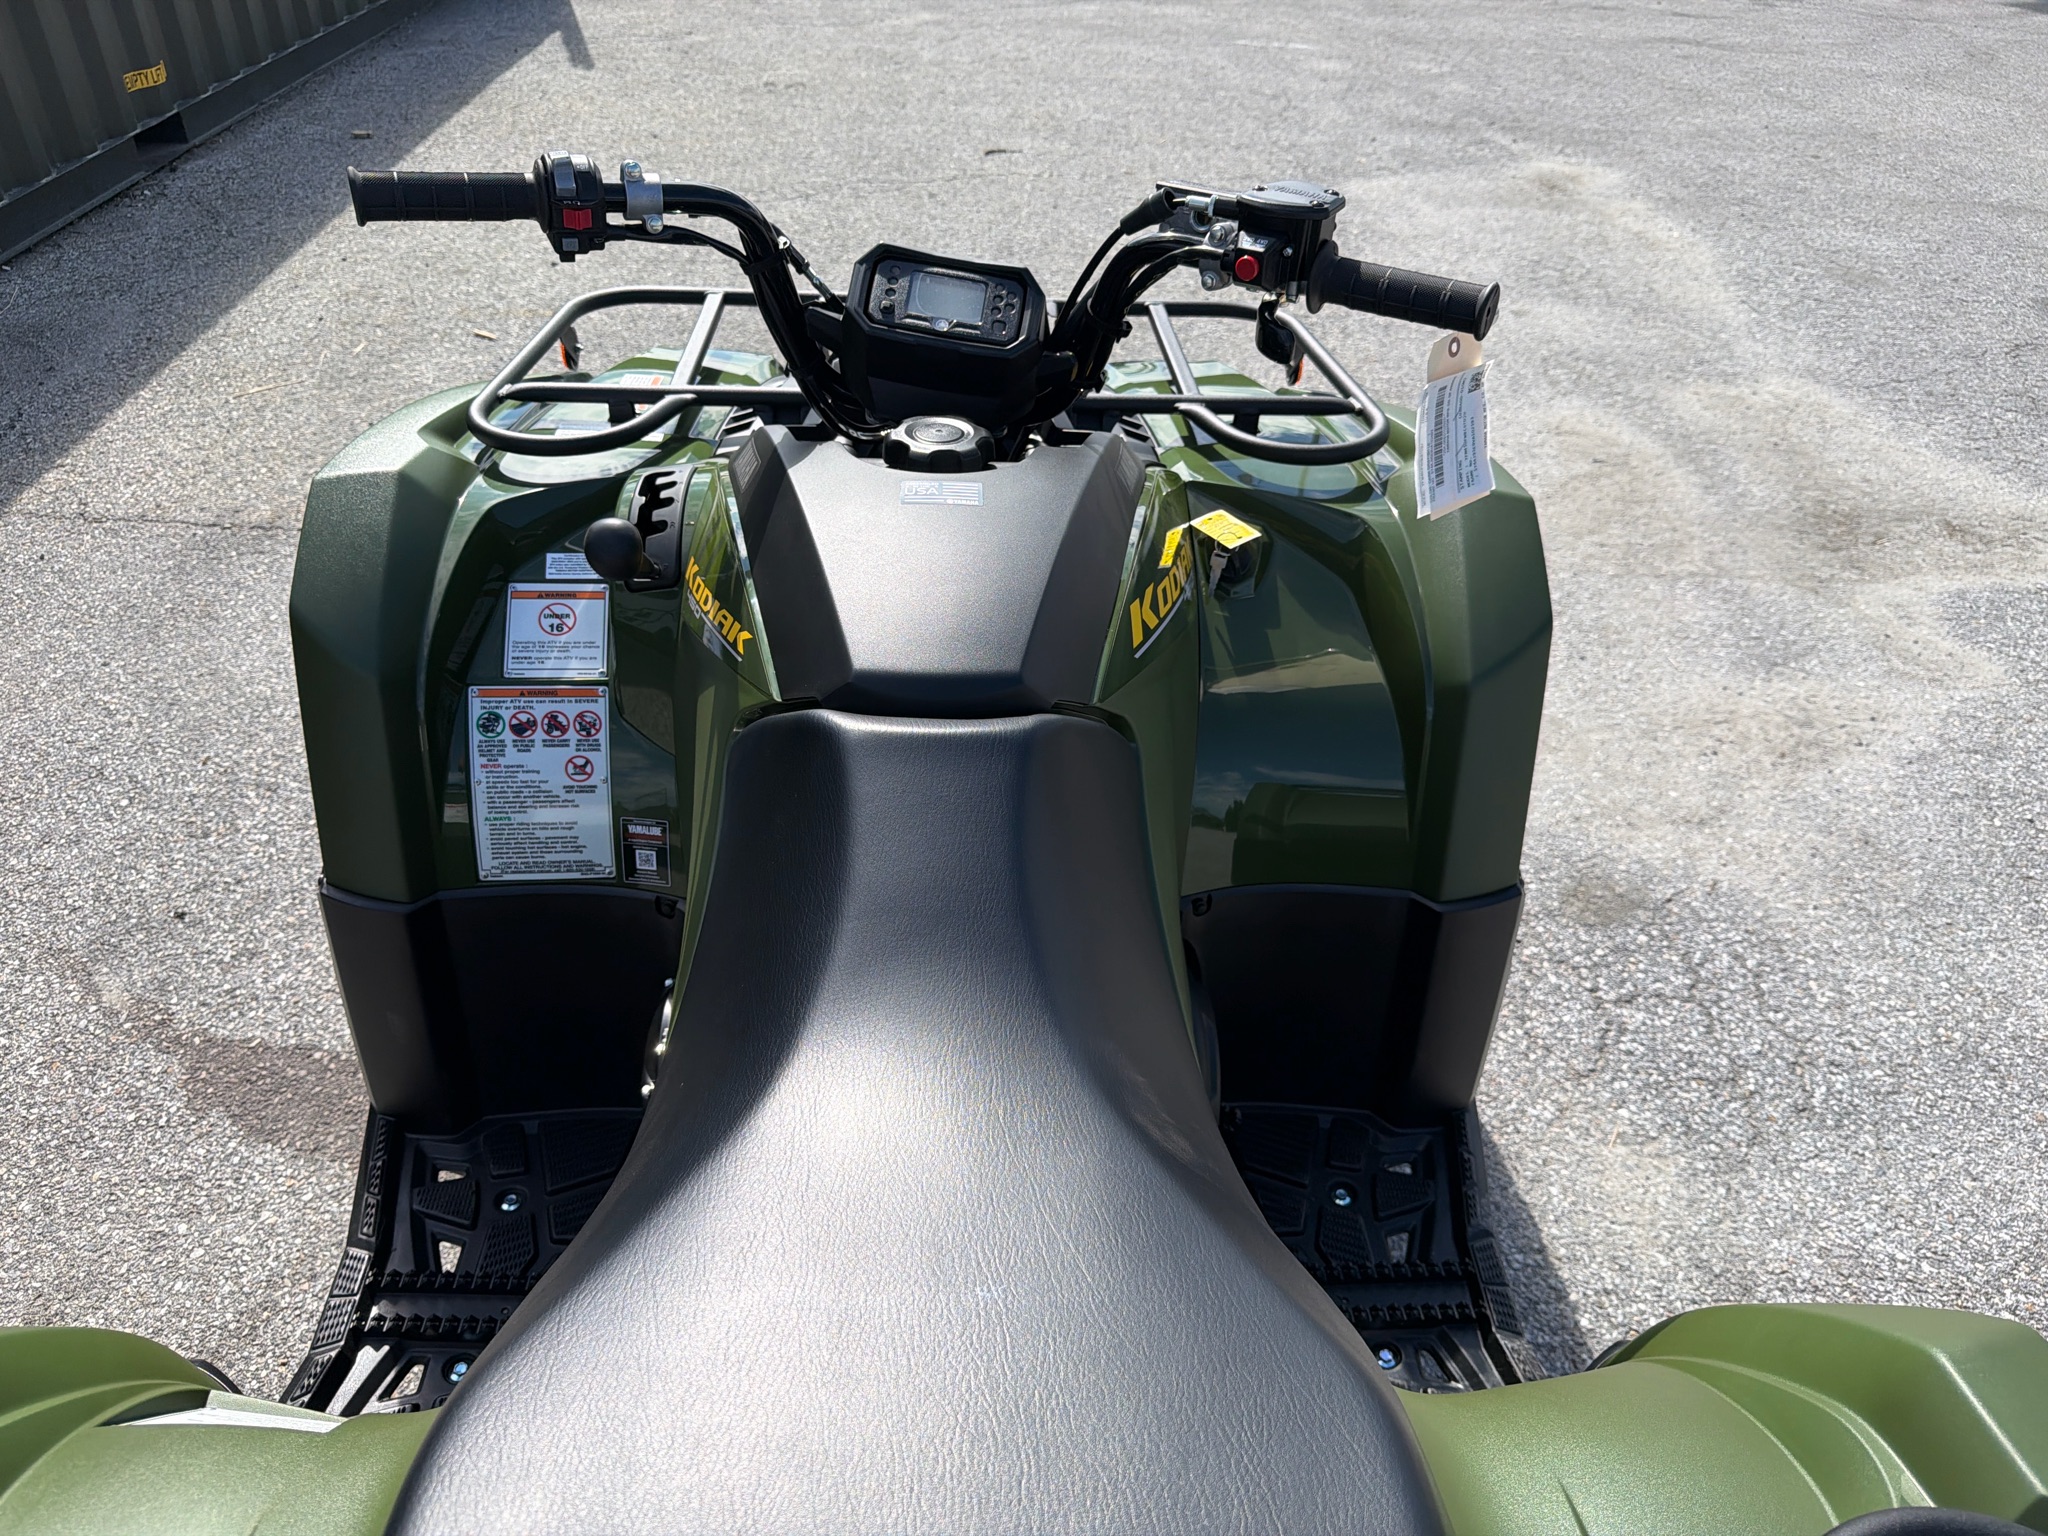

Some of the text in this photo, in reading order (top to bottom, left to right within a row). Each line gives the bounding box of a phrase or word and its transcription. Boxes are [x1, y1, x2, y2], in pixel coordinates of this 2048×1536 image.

[904, 487, 939, 495] USA
[685, 556, 753, 655] KODIAK
[548, 623, 564, 632] 16
[627, 825, 663, 836] YAMALUBE
